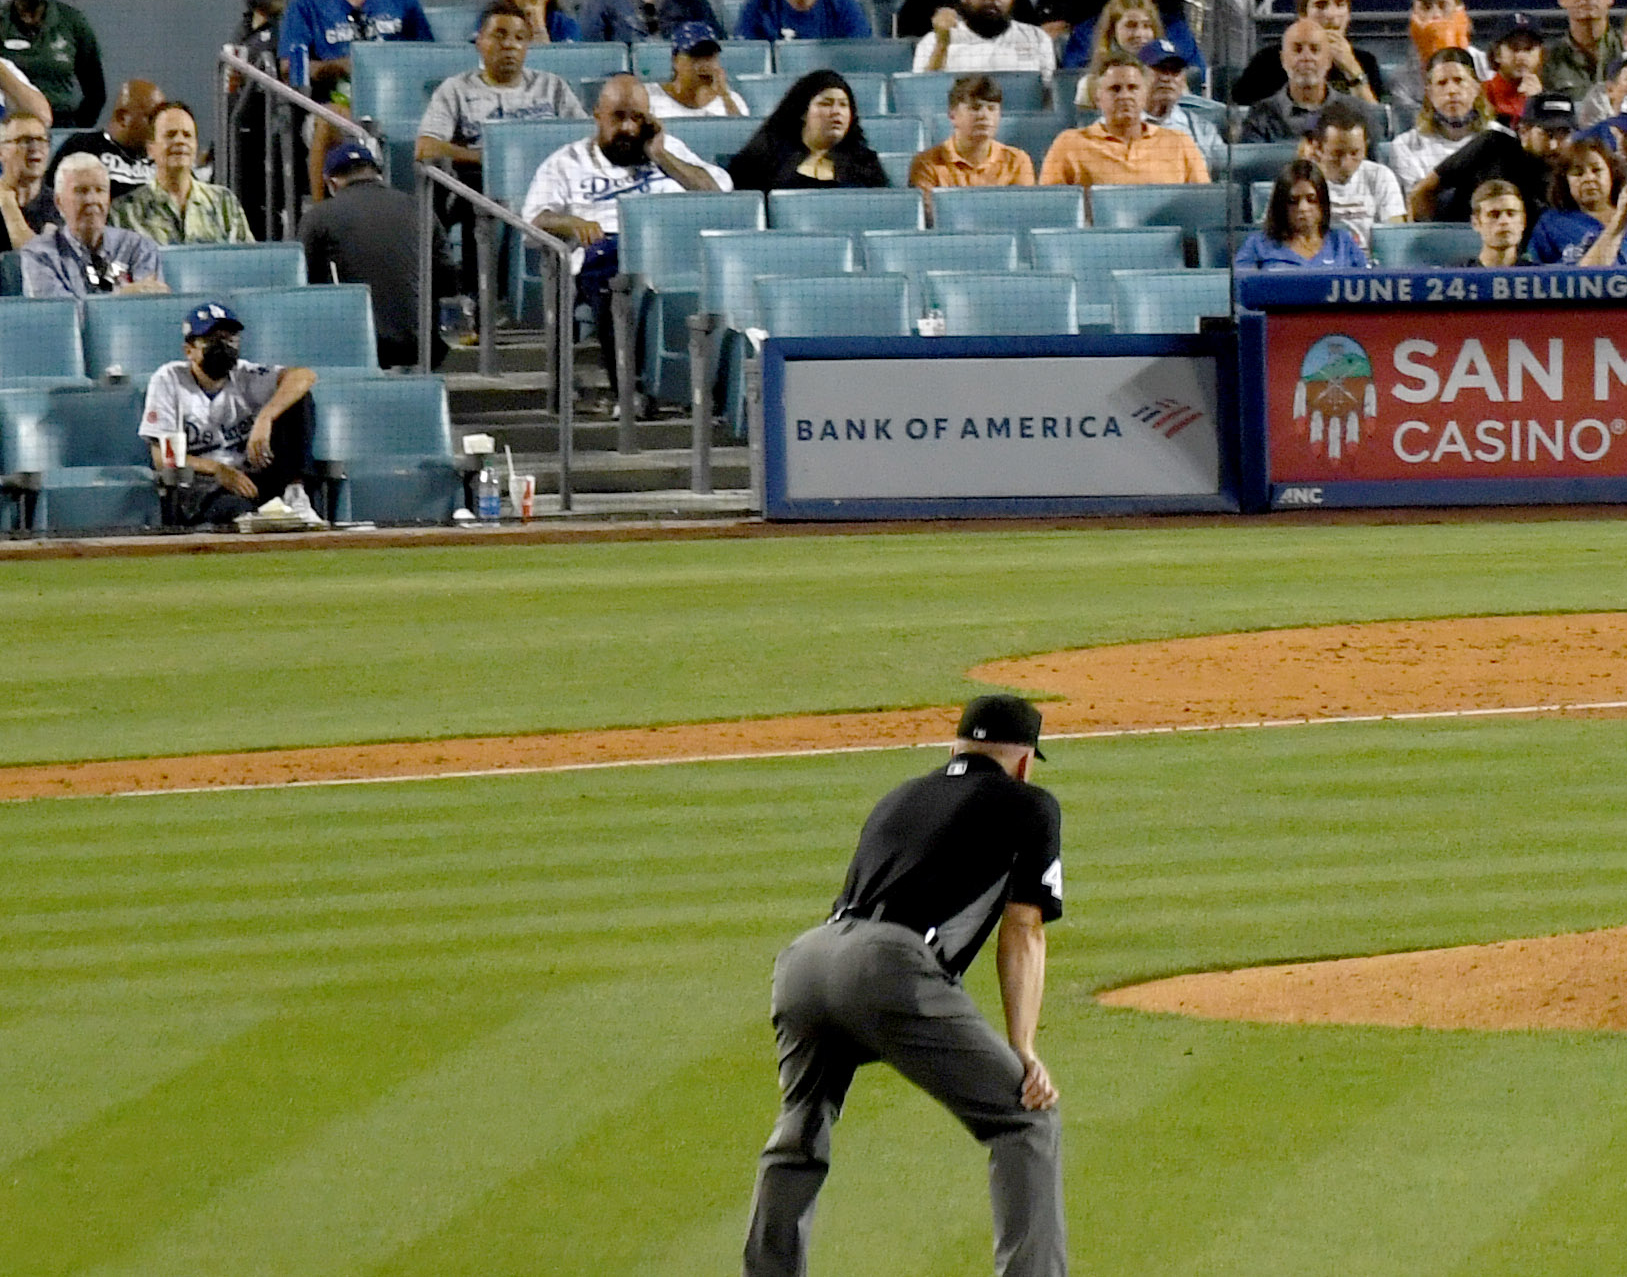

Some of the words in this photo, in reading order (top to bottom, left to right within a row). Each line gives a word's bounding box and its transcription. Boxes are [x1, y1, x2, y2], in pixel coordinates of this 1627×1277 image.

[1326, 279, 1411, 303] JUNE
[1426, 278, 1479, 301] 24:
[1391, 338, 1564, 404] SAN
[796, 419, 893, 442] BANK
[905, 417, 949, 441] OF
[959, 415, 1124, 441] AMERICA
[1277, 487, 1324, 505] ANC
